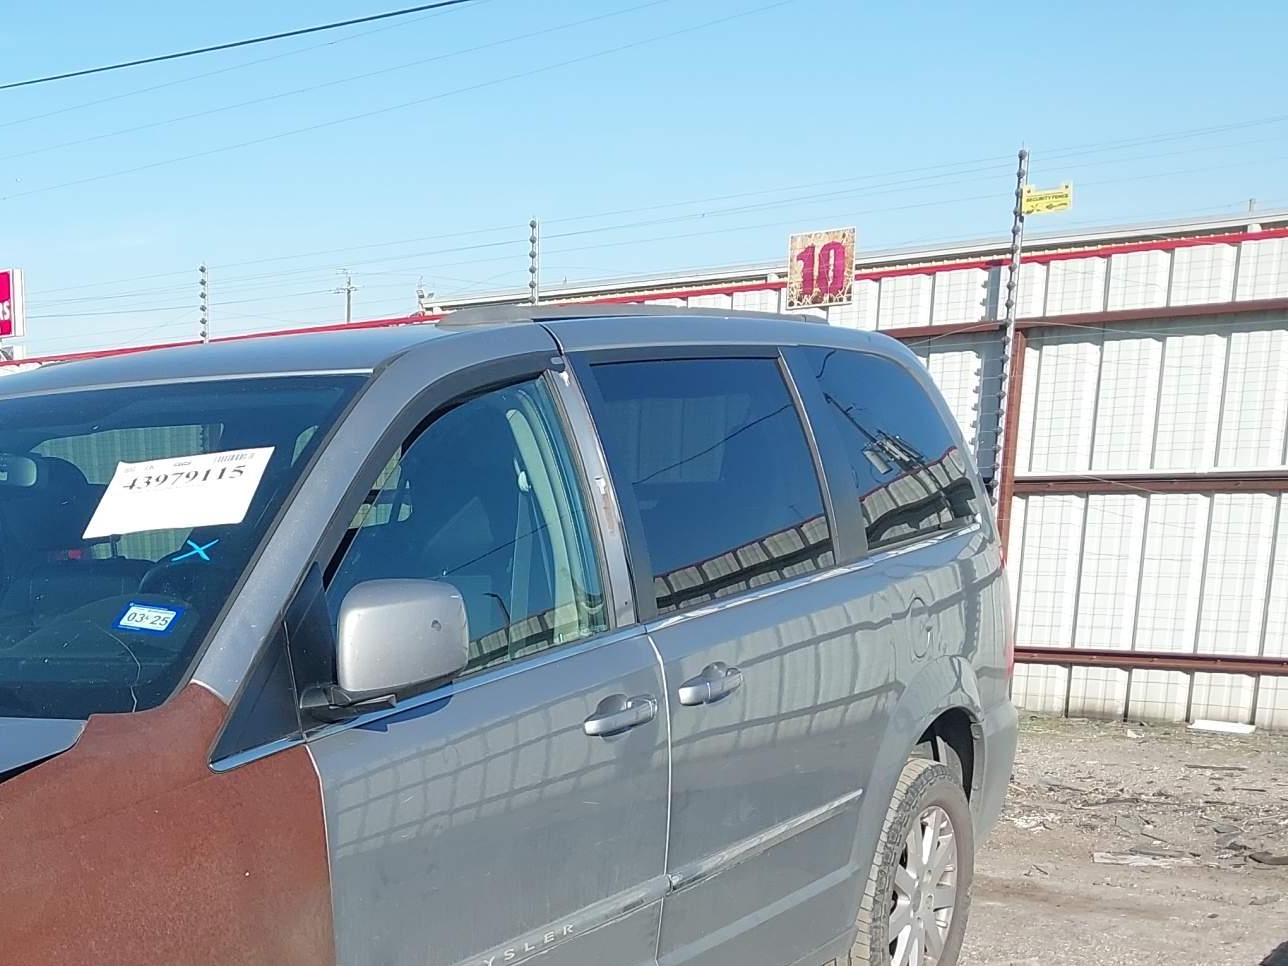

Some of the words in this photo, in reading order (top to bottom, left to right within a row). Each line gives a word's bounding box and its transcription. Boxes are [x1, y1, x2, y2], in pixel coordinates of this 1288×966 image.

[796, 241, 846, 297] 10
[122, 465, 246, 490] 43979115
[149, 615, 171, 627] 25
